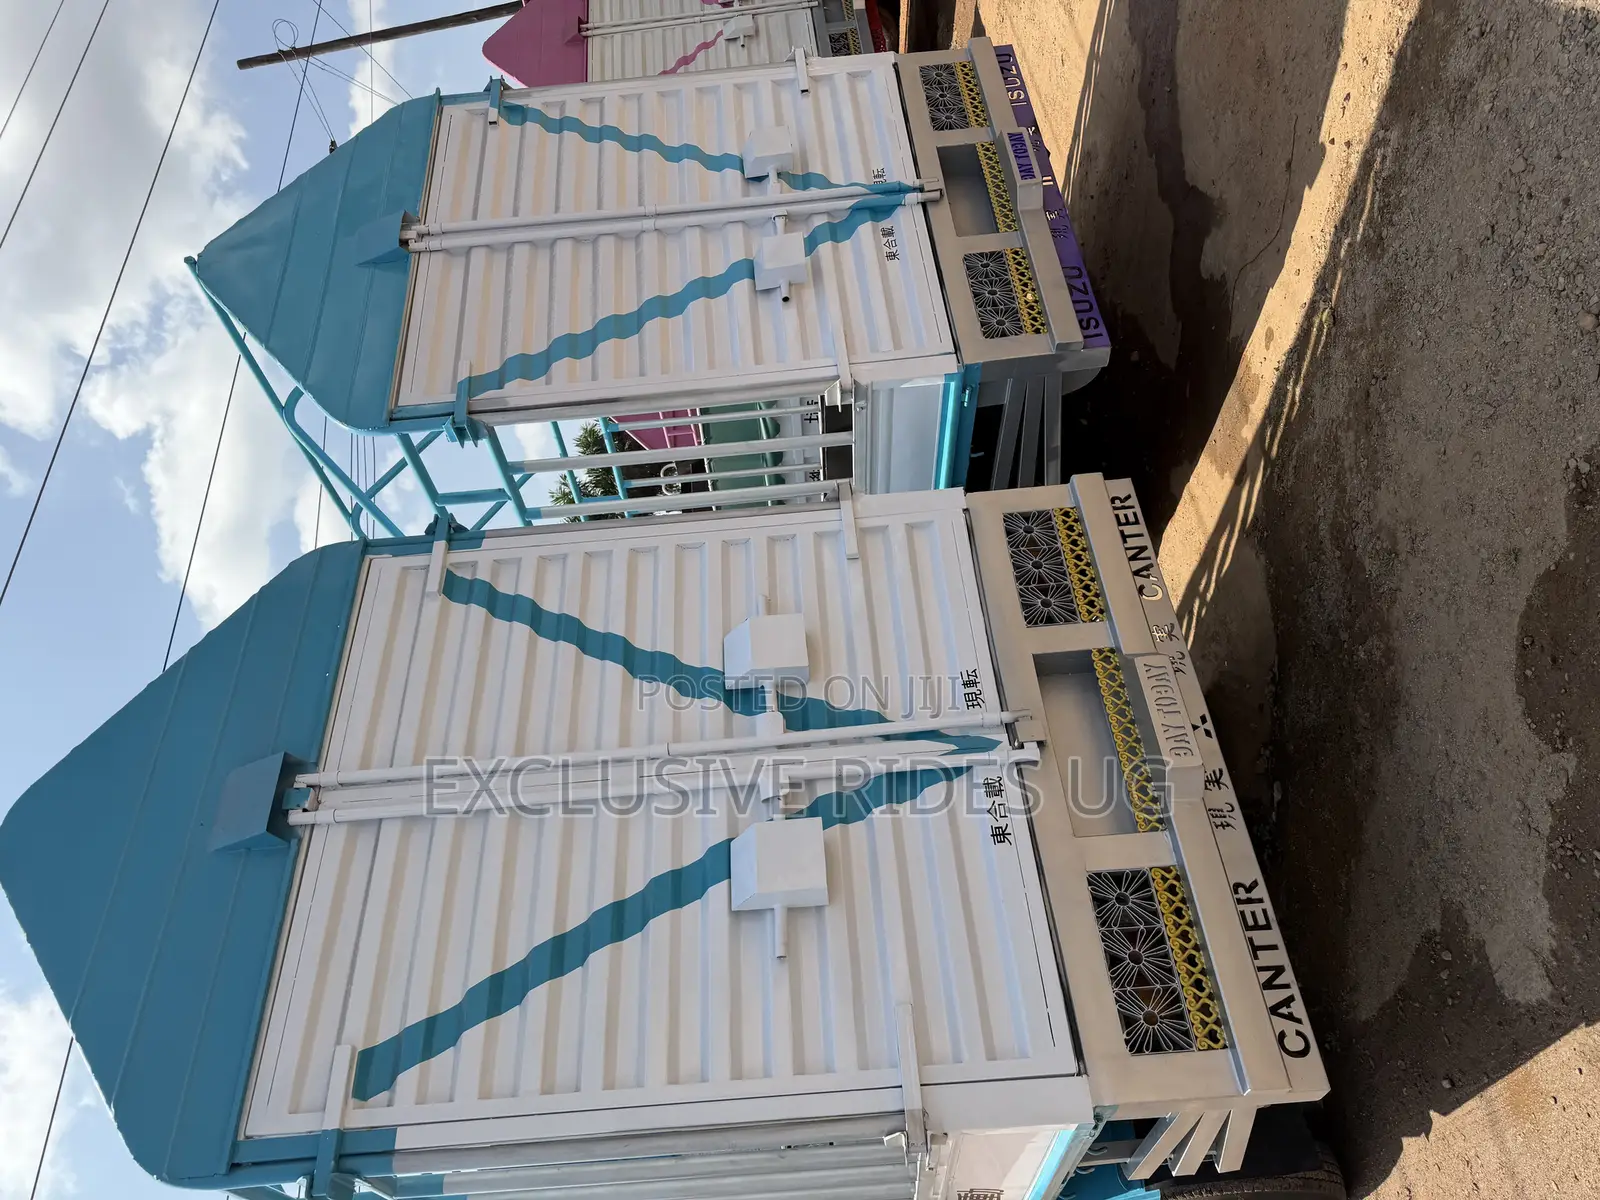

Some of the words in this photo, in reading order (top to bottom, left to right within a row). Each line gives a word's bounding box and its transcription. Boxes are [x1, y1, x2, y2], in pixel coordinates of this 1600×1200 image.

[996, 52, 1027, 107] ISUZU
[1068, 265, 1104, 340] ISUZU
[1111, 493, 1163, 600] CANTER
[1161, 723, 1194, 757] DAY
[982, 776, 1013, 846] 東合載
[1232, 877, 1313, 1060] CANTER
